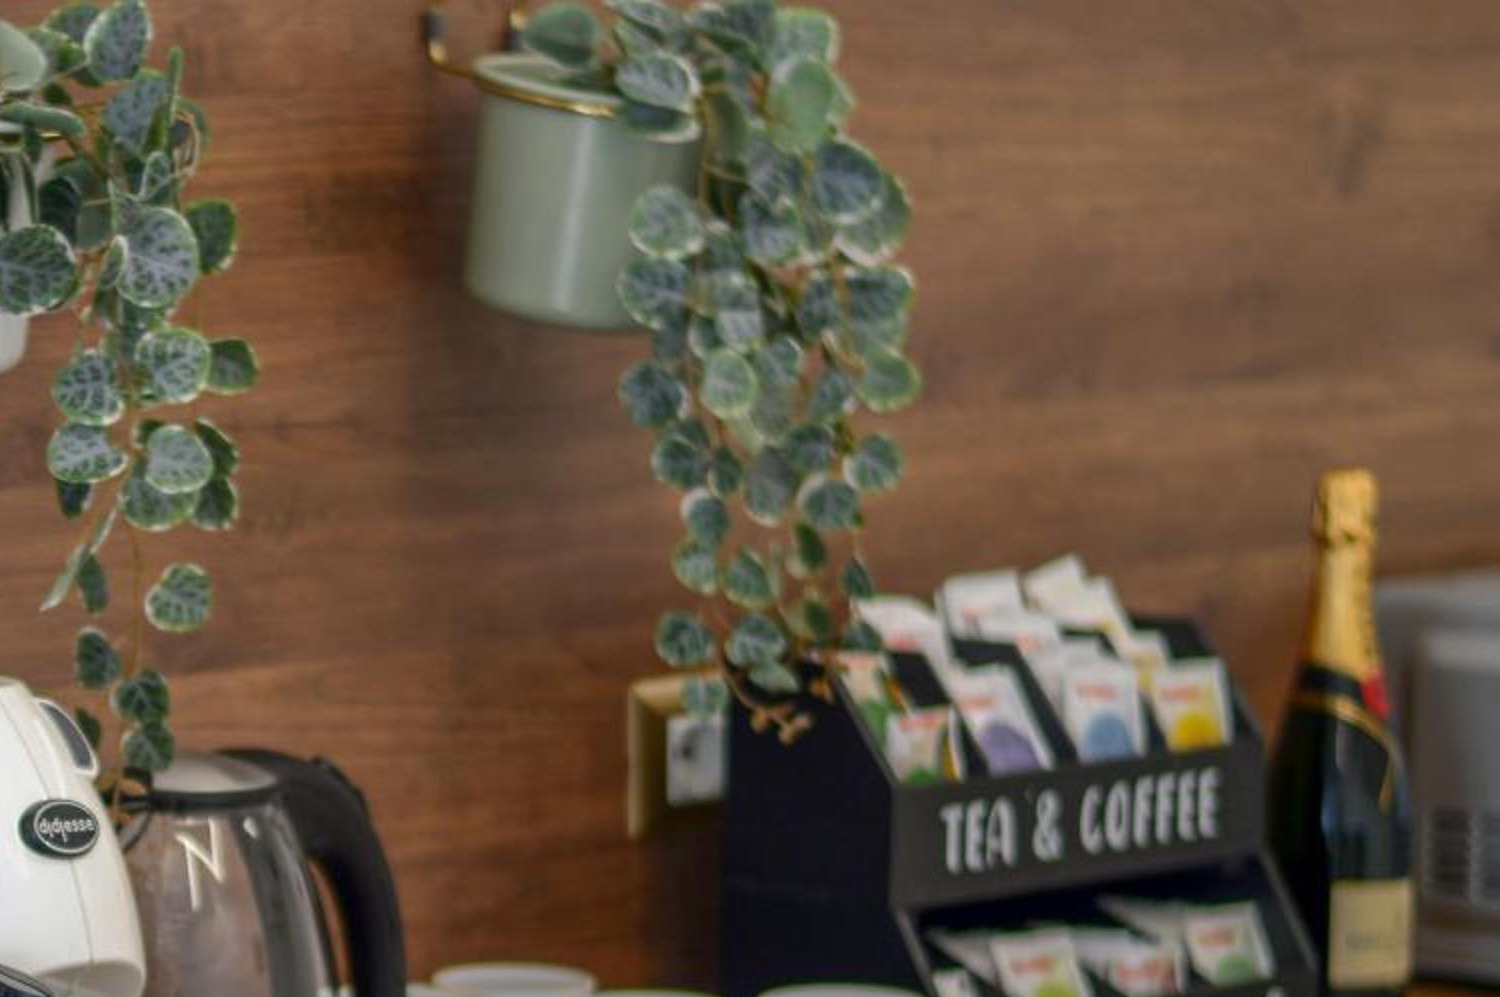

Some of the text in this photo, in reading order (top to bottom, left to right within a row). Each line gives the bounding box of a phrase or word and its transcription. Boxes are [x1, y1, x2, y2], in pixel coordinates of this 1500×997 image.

[940, 766, 1220, 875] TEA & COFFEE
